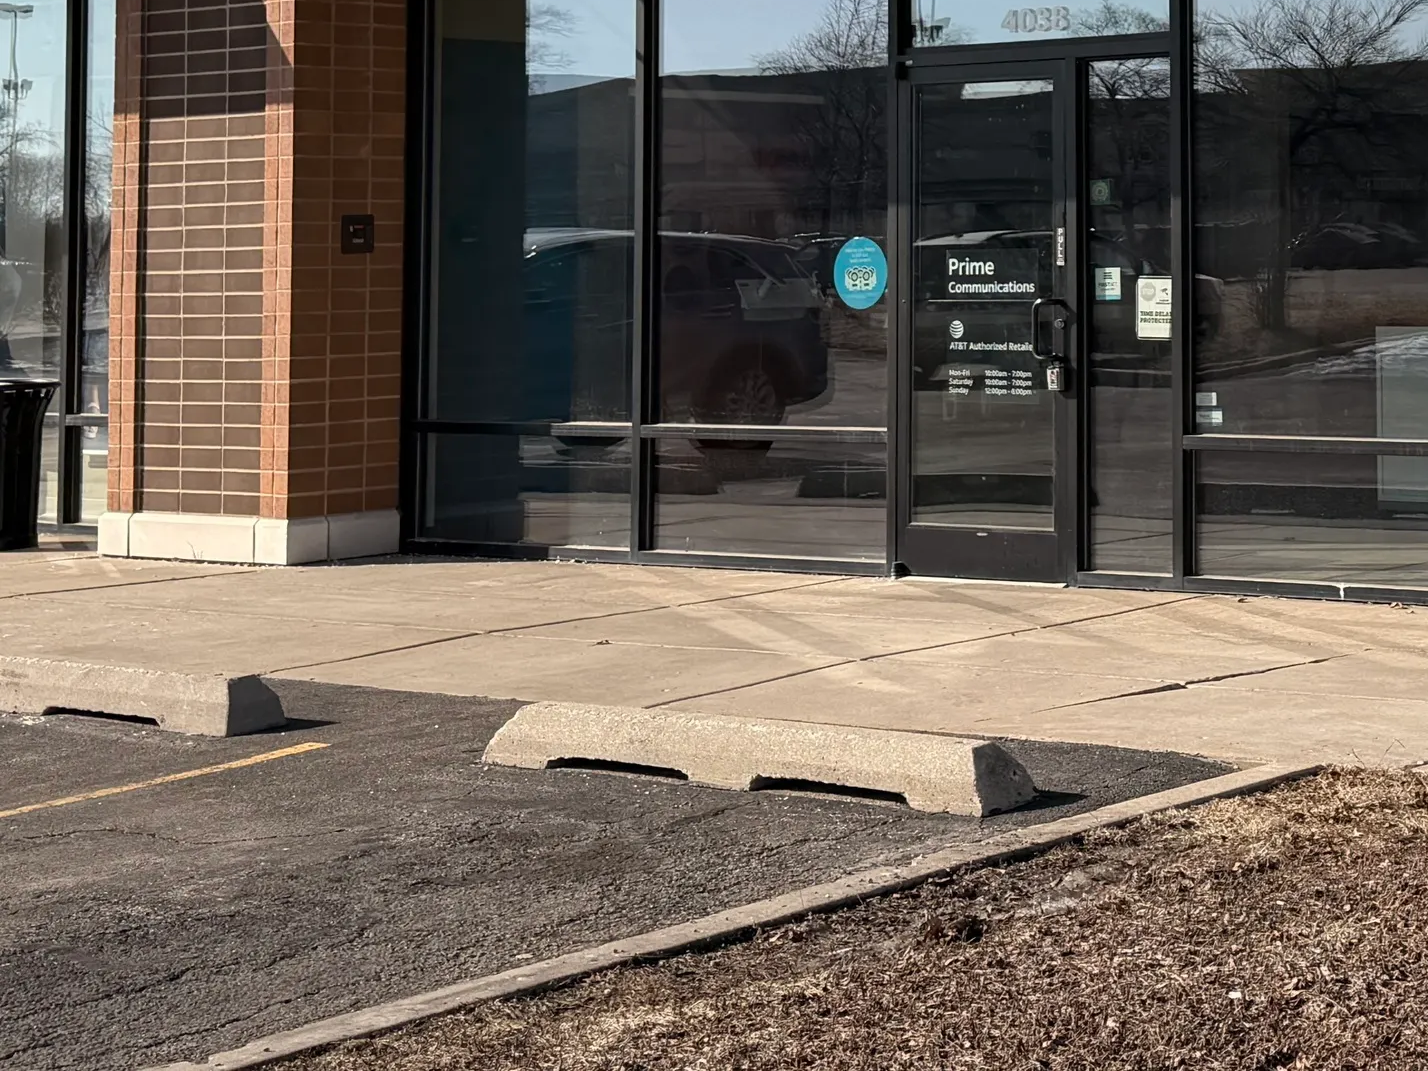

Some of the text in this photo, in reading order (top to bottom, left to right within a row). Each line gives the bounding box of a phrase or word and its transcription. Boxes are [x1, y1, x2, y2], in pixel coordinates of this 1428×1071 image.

[949, 257, 994, 275] Prime
[949, 281, 1035, 293] Communications
[950, 342, 1033, 350] AT&T Authorized Retaile
[949, 378, 973, 386] Saturday
[949, 387, 969, 395] Sunday
